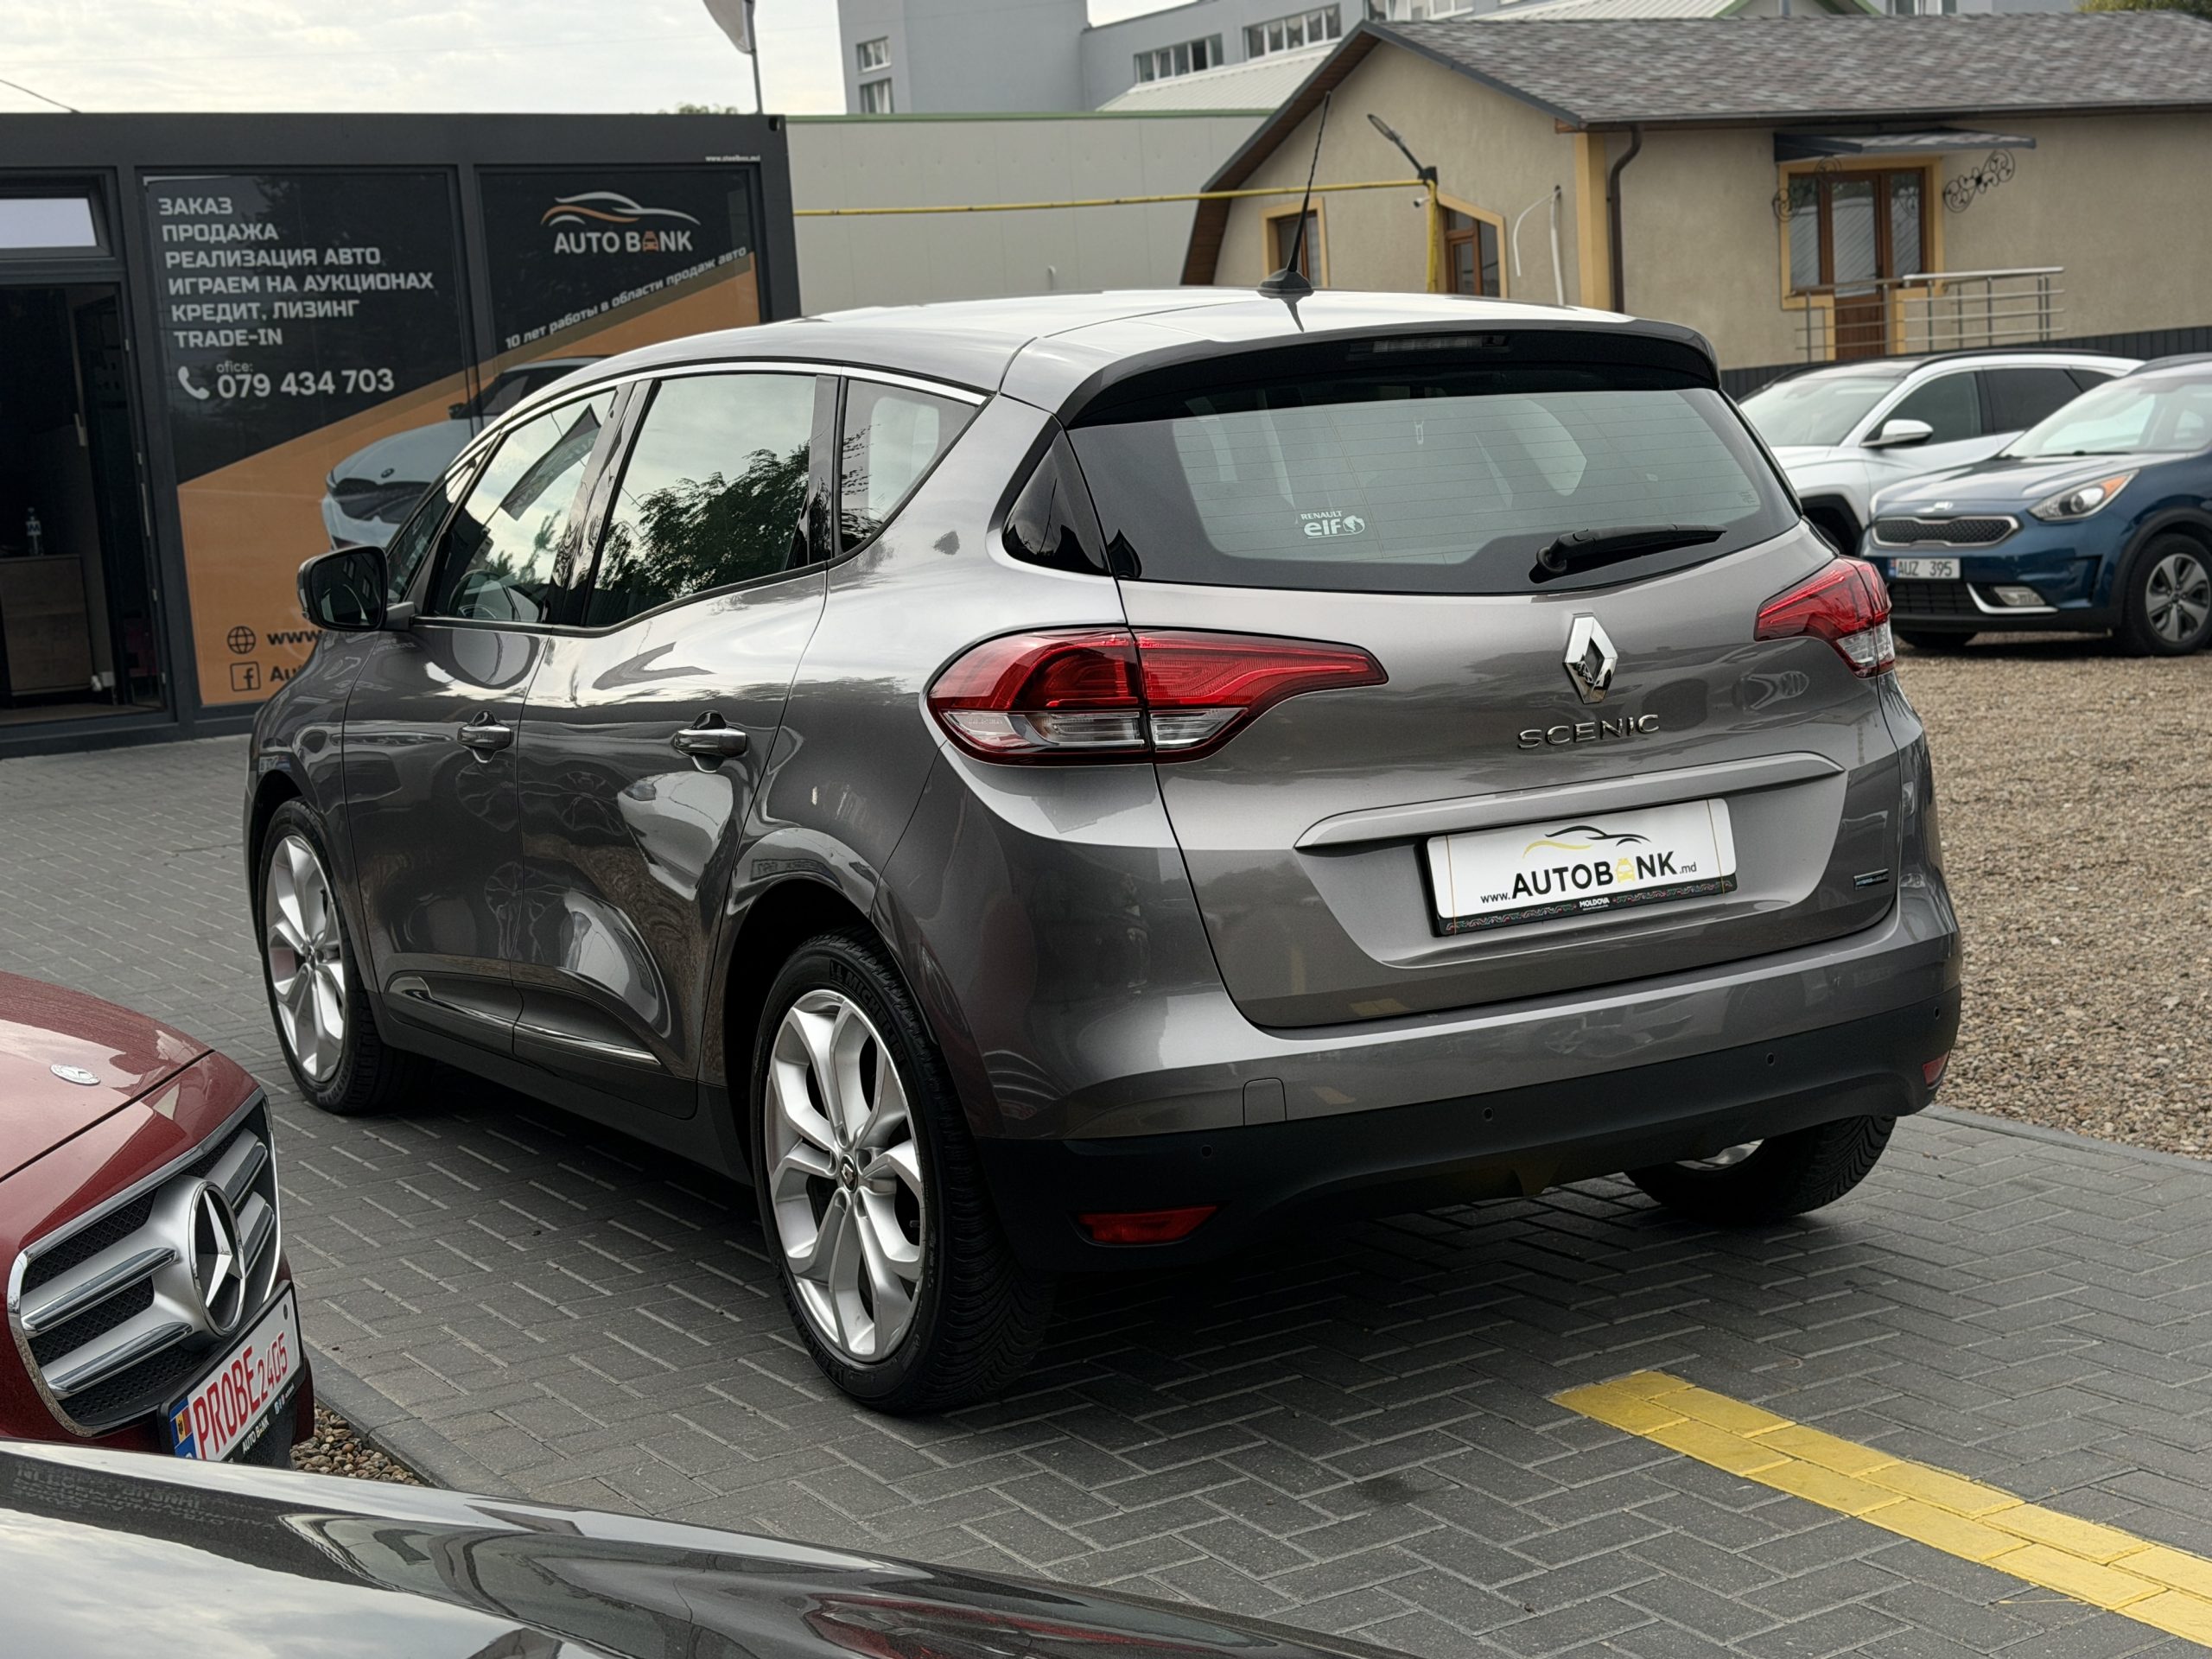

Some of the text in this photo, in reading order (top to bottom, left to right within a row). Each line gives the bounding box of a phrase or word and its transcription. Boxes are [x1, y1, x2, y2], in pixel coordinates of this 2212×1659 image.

[158, 197, 233, 215] ЗАКАЗ
[162, 223, 279, 244] ПРОДАЖА
[554, 232, 620, 254] AUTO
[165, 247, 381, 269] РЕАЛИЗАЦИЯ АВТО
[168, 272, 434, 295] ИГРАЕМ НА АУКЦИОНАХ
[505, 246, 747, 349] 10 лет работы в области продаж авто
[172, 300, 360, 323] КРЕДИТ, ЛИЗИНГ
[174, 328, 283, 348] TRADE-IN
[217, 368, 395, 398] 079 434 703
[1300, 511, 1342, 520] RENAULT
[1304, 518, 1341, 536] elf
[1897, 561, 1953, 576] AUZ 395
[1518, 714, 1660, 748] SCENIC
[1579, 897, 1610, 908] MOLDOVA
[192, 1332, 288, 1460] PROBE 2405
